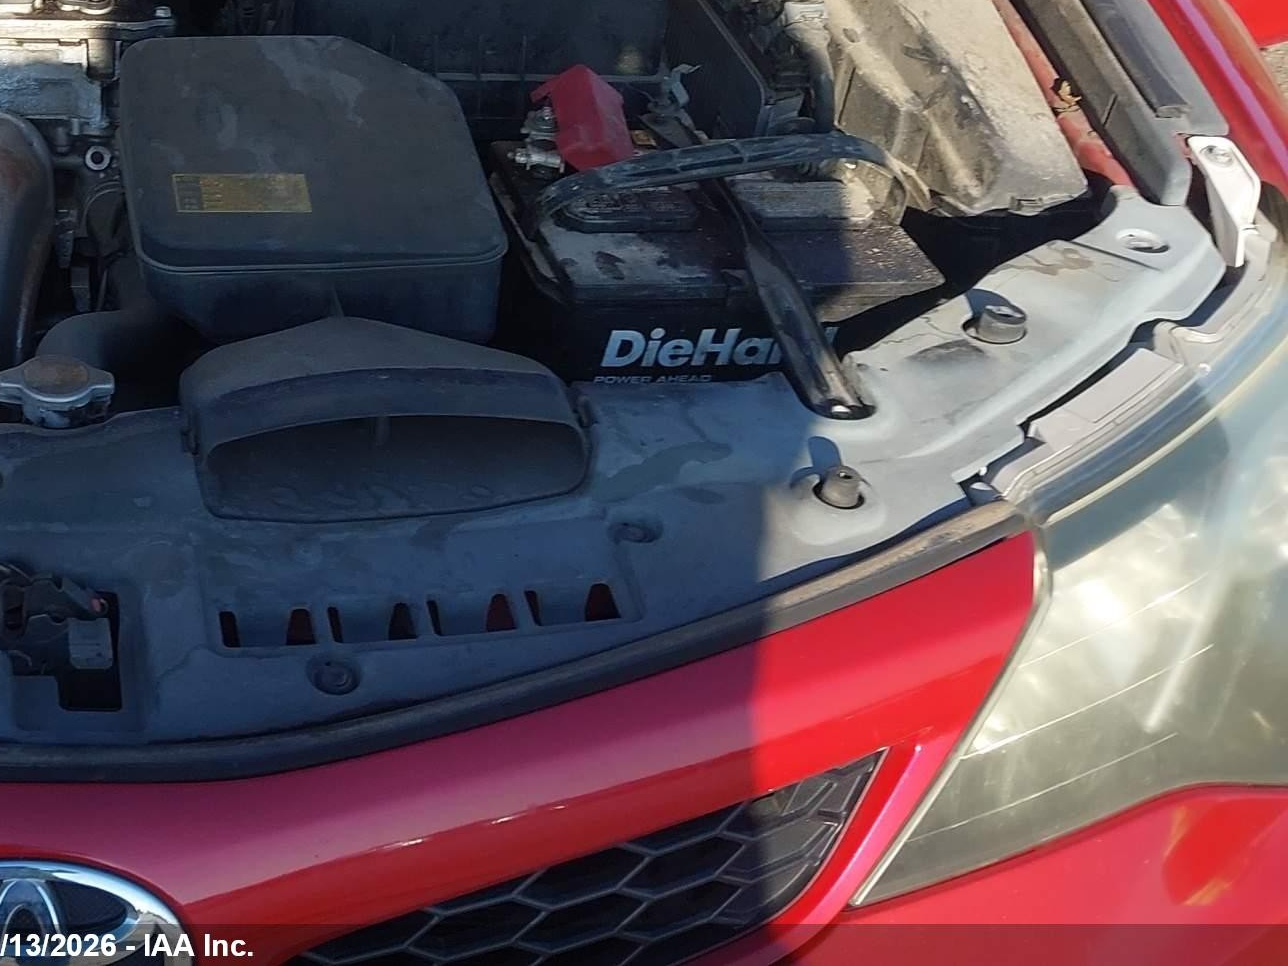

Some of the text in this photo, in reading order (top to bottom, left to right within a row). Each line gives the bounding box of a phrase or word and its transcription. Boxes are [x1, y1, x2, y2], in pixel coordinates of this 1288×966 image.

[601, 326, 839, 368] DieHa
[593, 374, 713, 384] POWER AHEAD
